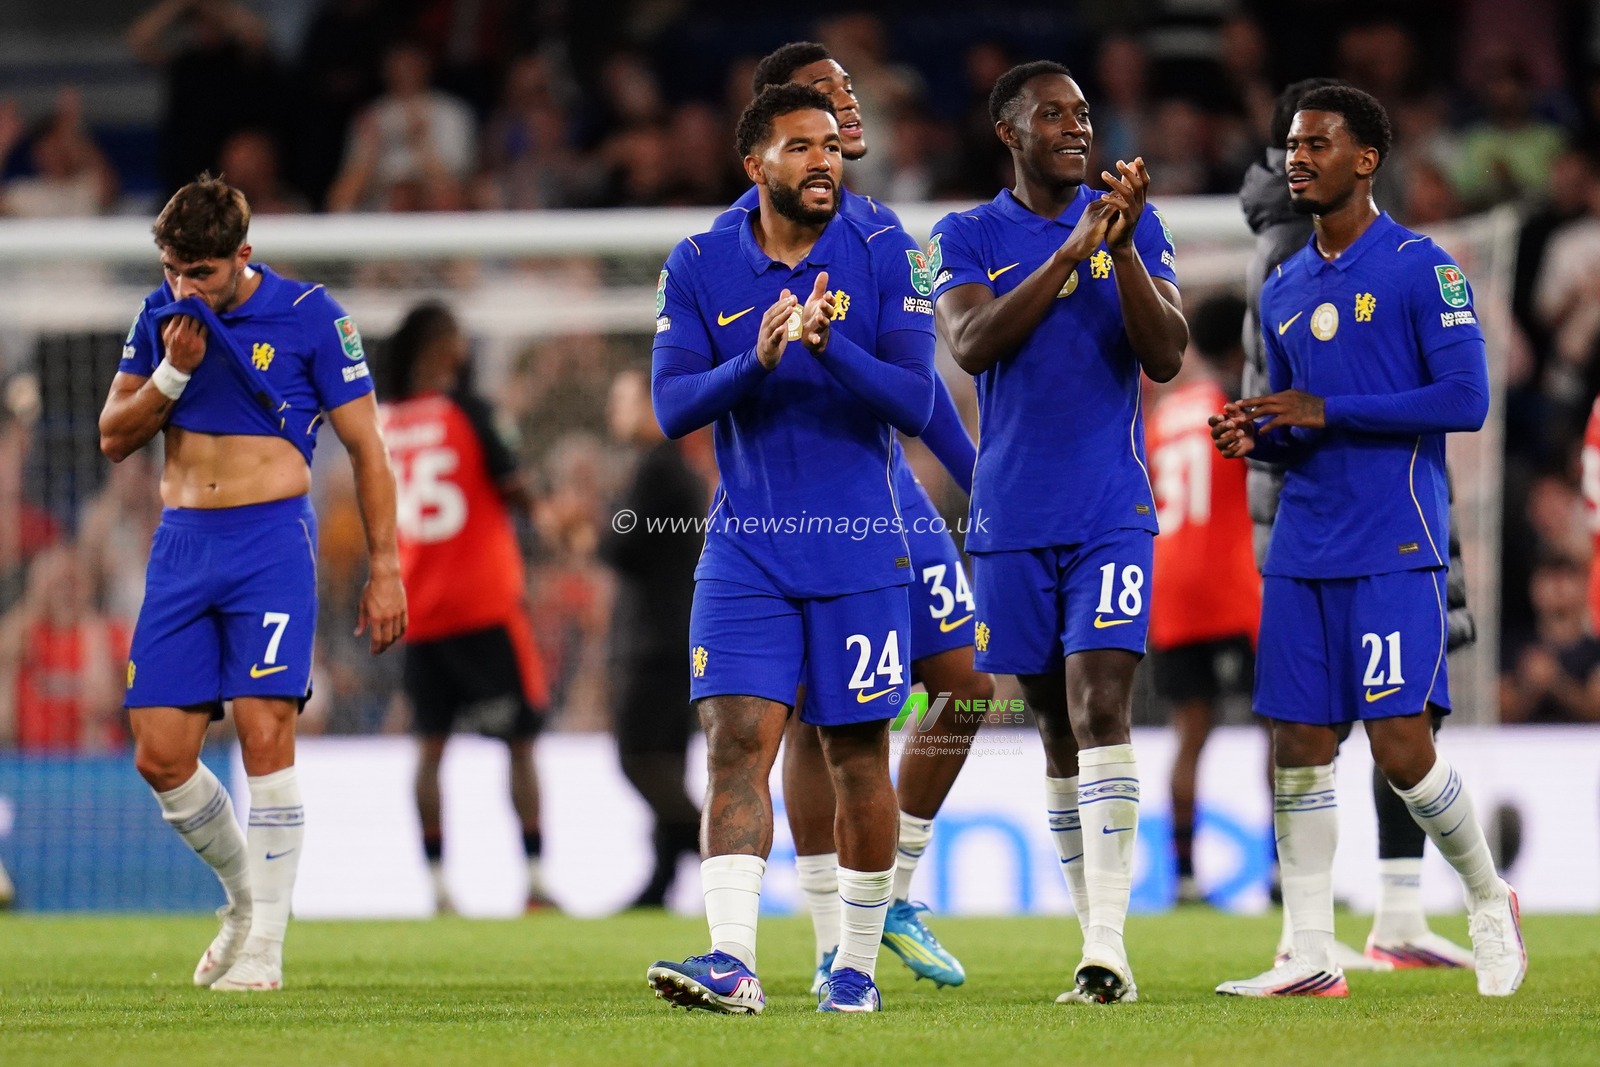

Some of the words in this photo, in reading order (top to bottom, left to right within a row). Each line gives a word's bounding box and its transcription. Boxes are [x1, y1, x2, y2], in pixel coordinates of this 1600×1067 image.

[904, 296, 917, 306] No
[1440, 312, 1455, 321] No
[922, 560, 976, 619] 34
[1095, 562, 1144, 616] 18
[262, 611, 290, 665] 7
[846, 630, 904, 690] 24
[1361, 630, 1405, 687] 21
